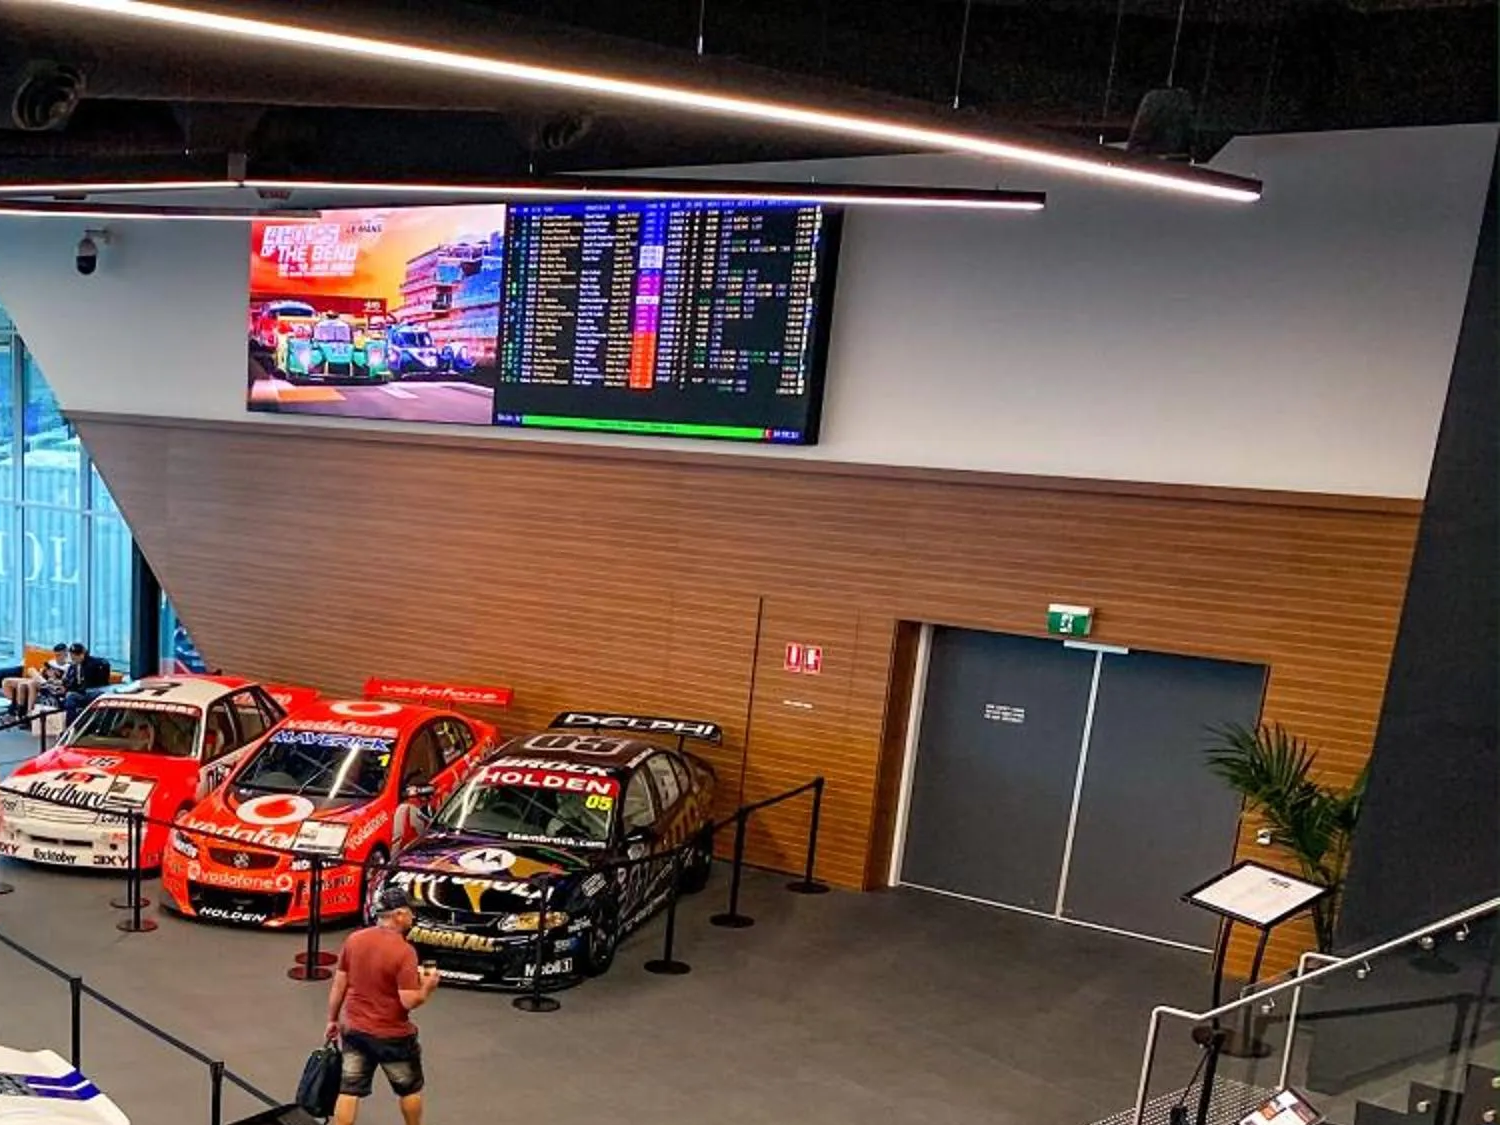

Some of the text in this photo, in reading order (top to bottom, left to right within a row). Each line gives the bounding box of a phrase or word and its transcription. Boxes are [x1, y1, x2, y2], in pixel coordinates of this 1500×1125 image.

[277, 245, 309, 262] THE
[310, 243, 358, 261] BEND
[380, 684, 499, 701] vodafone
[564, 713, 715, 735] DELPHI
[492, 756, 613, 777] BROCK
[481, 771, 612, 794] HOLDEN
[28, 780, 107, 808] Marlboro
[585, 794, 613, 811] 05
[202, 869, 275, 889] vodafone
[199, 906, 268, 924] HOLDEN
